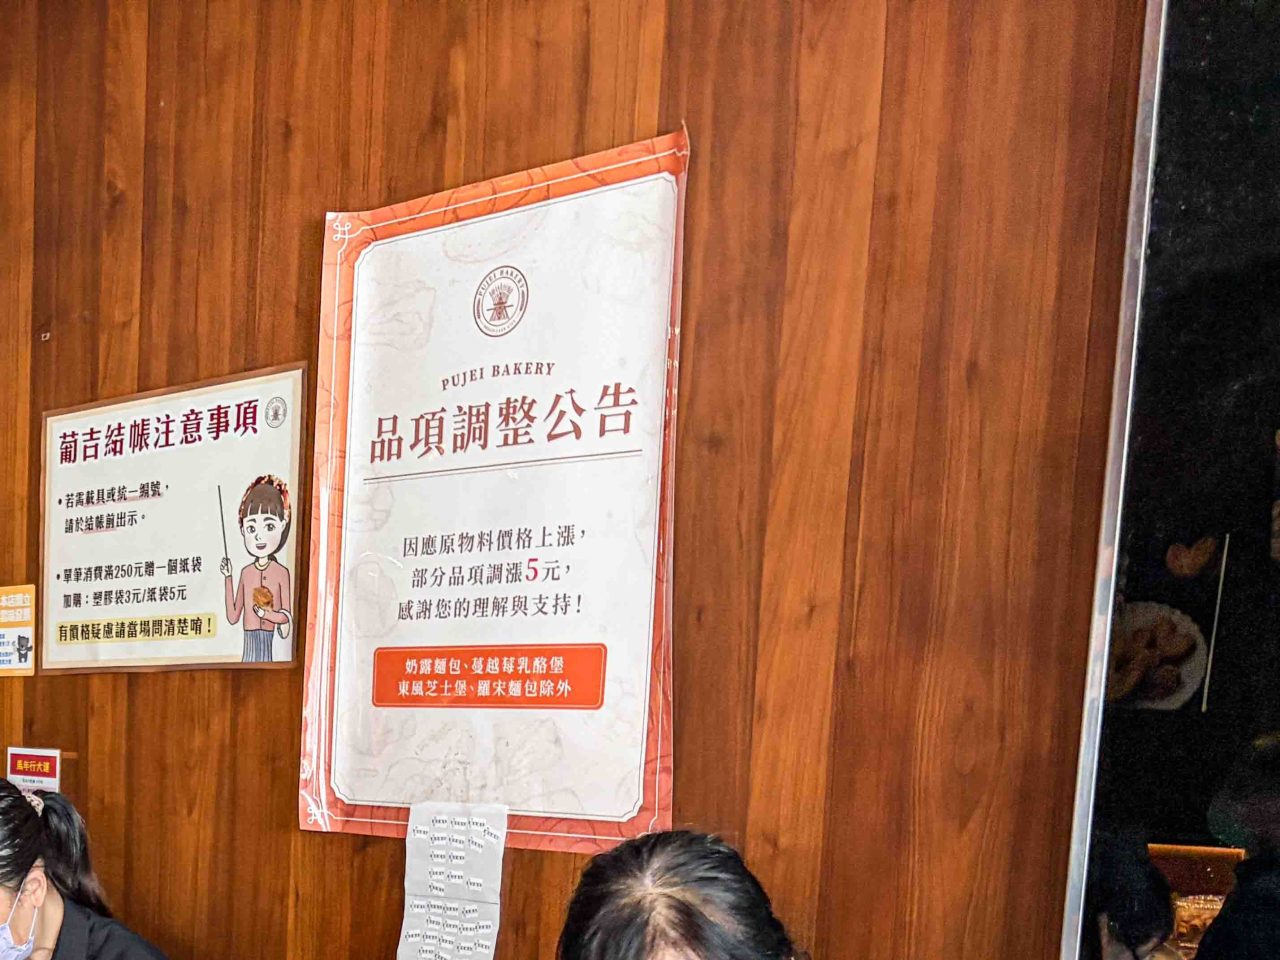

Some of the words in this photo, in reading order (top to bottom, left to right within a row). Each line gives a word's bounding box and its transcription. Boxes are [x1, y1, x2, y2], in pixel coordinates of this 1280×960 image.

[441, 371, 485, 391] PUJEI
[491, 362, 556, 378] BAKERY
[59, 399, 259, 464] 葡吉結帳注意事項
[370, 382, 638, 464] 品項調整公告
[63, 556, 202, 584] 單筆消費滿250元贈一個紙袋
[398, 680, 571, 698] 東風芝士堡、羅宋麵包除外
